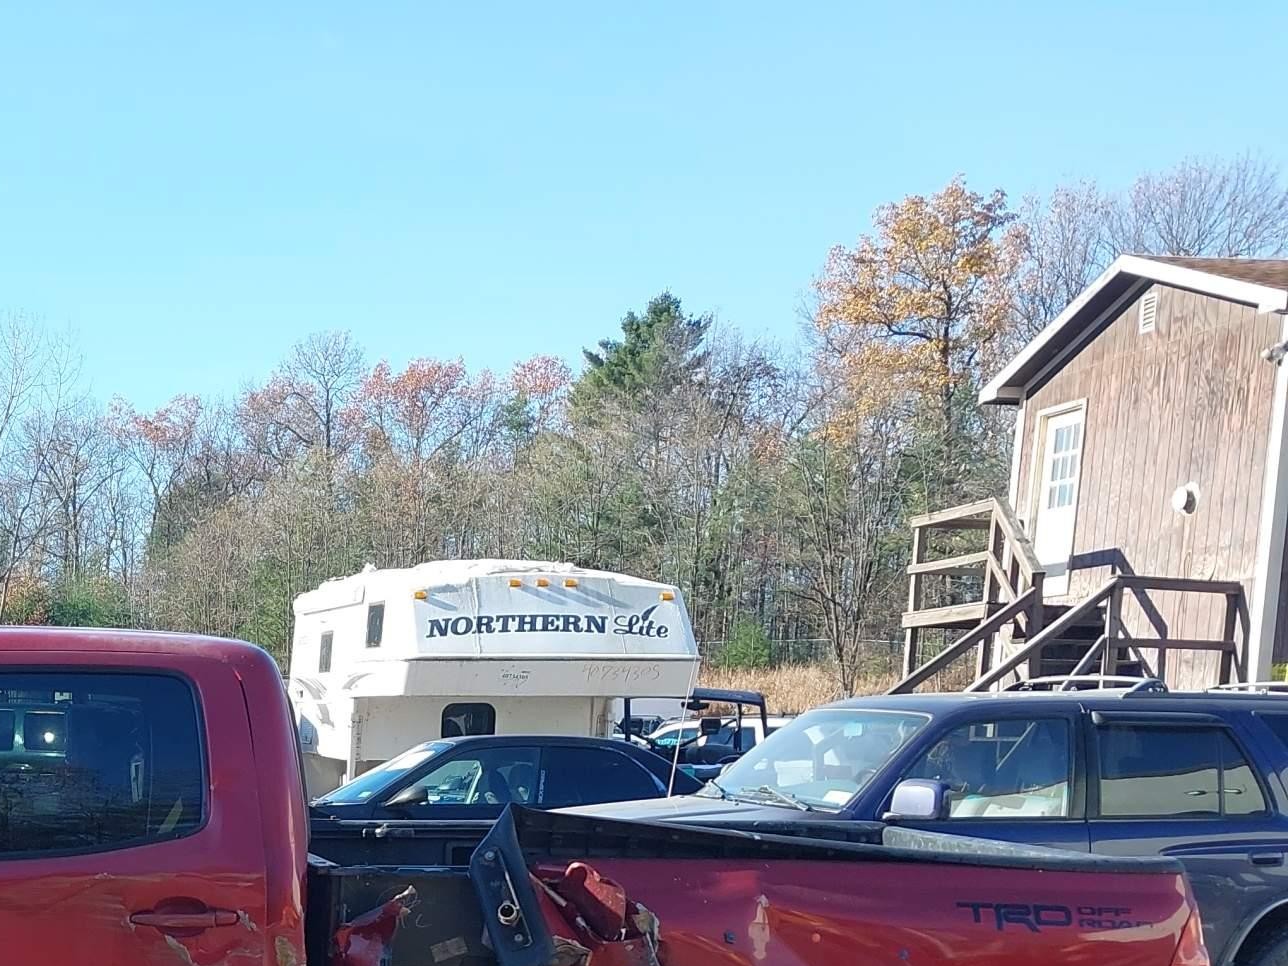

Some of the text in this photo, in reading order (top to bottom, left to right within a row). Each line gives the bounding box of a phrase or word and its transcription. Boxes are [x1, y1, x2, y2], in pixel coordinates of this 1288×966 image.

[426, 605, 669, 639] NORTHERN Lite
[956, 902, 1073, 932] TRD
[1077, 906, 1132, 917] OFF
